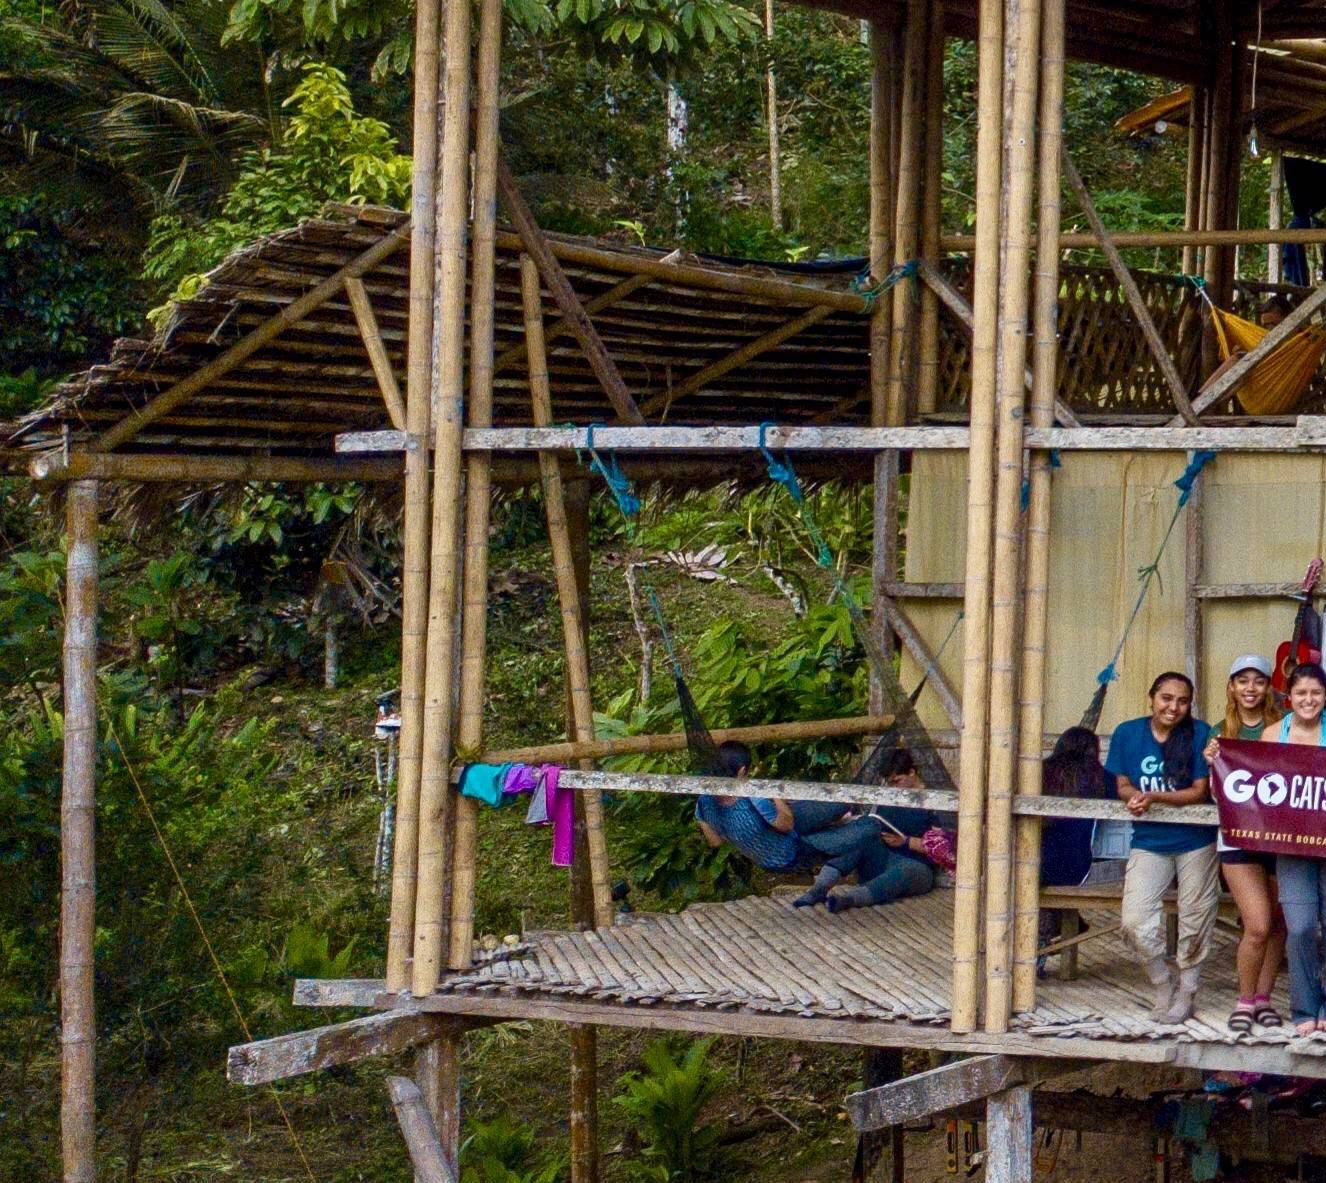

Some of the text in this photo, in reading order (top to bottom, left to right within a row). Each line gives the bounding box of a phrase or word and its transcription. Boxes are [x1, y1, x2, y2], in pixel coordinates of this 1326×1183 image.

[1223, 769, 1288, 807] GO
[1230, 828, 1261, 840] TEXAS
[1264, 831, 1293, 842] STATE
